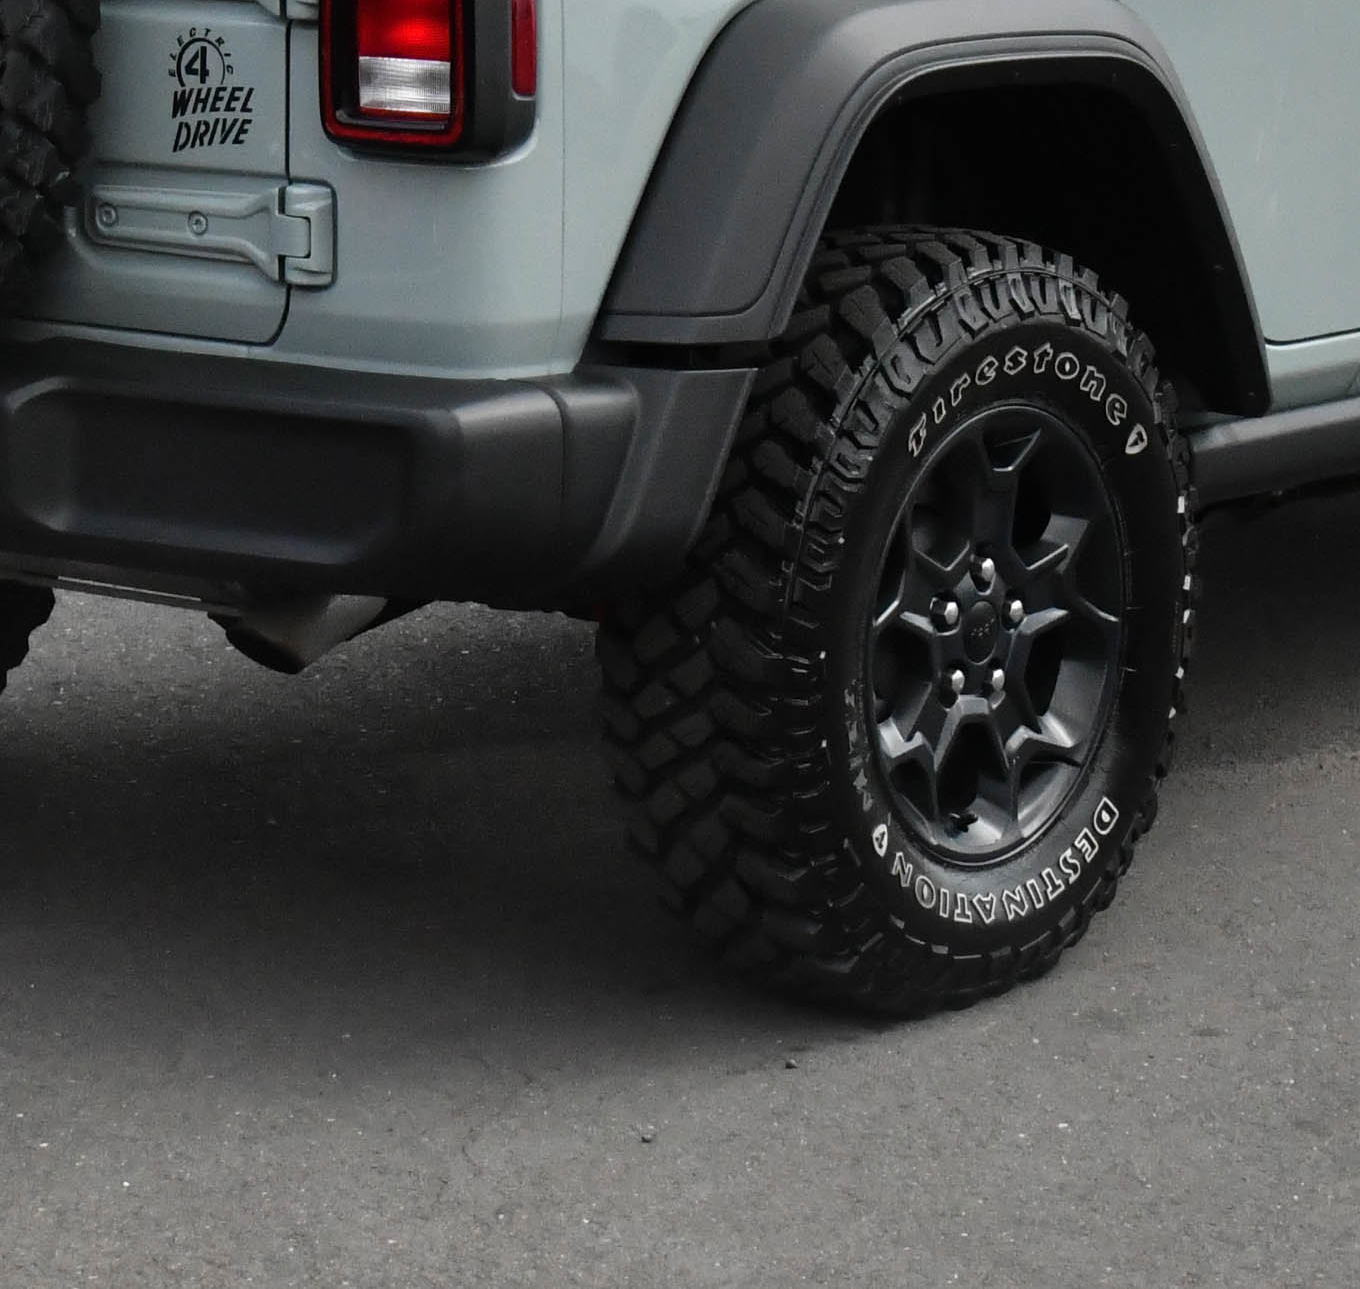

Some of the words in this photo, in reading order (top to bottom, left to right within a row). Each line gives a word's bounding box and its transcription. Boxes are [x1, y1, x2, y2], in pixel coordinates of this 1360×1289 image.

[168, 27, 234, 78] ELECTRIC
[185, 45, 210, 85] 4
[171, 86, 255, 119] WHEEL
[172, 117, 253, 153] DRIVE
[907, 340, 1129, 459] Firestone
[890, 795, 1121, 925] DESTINATION
